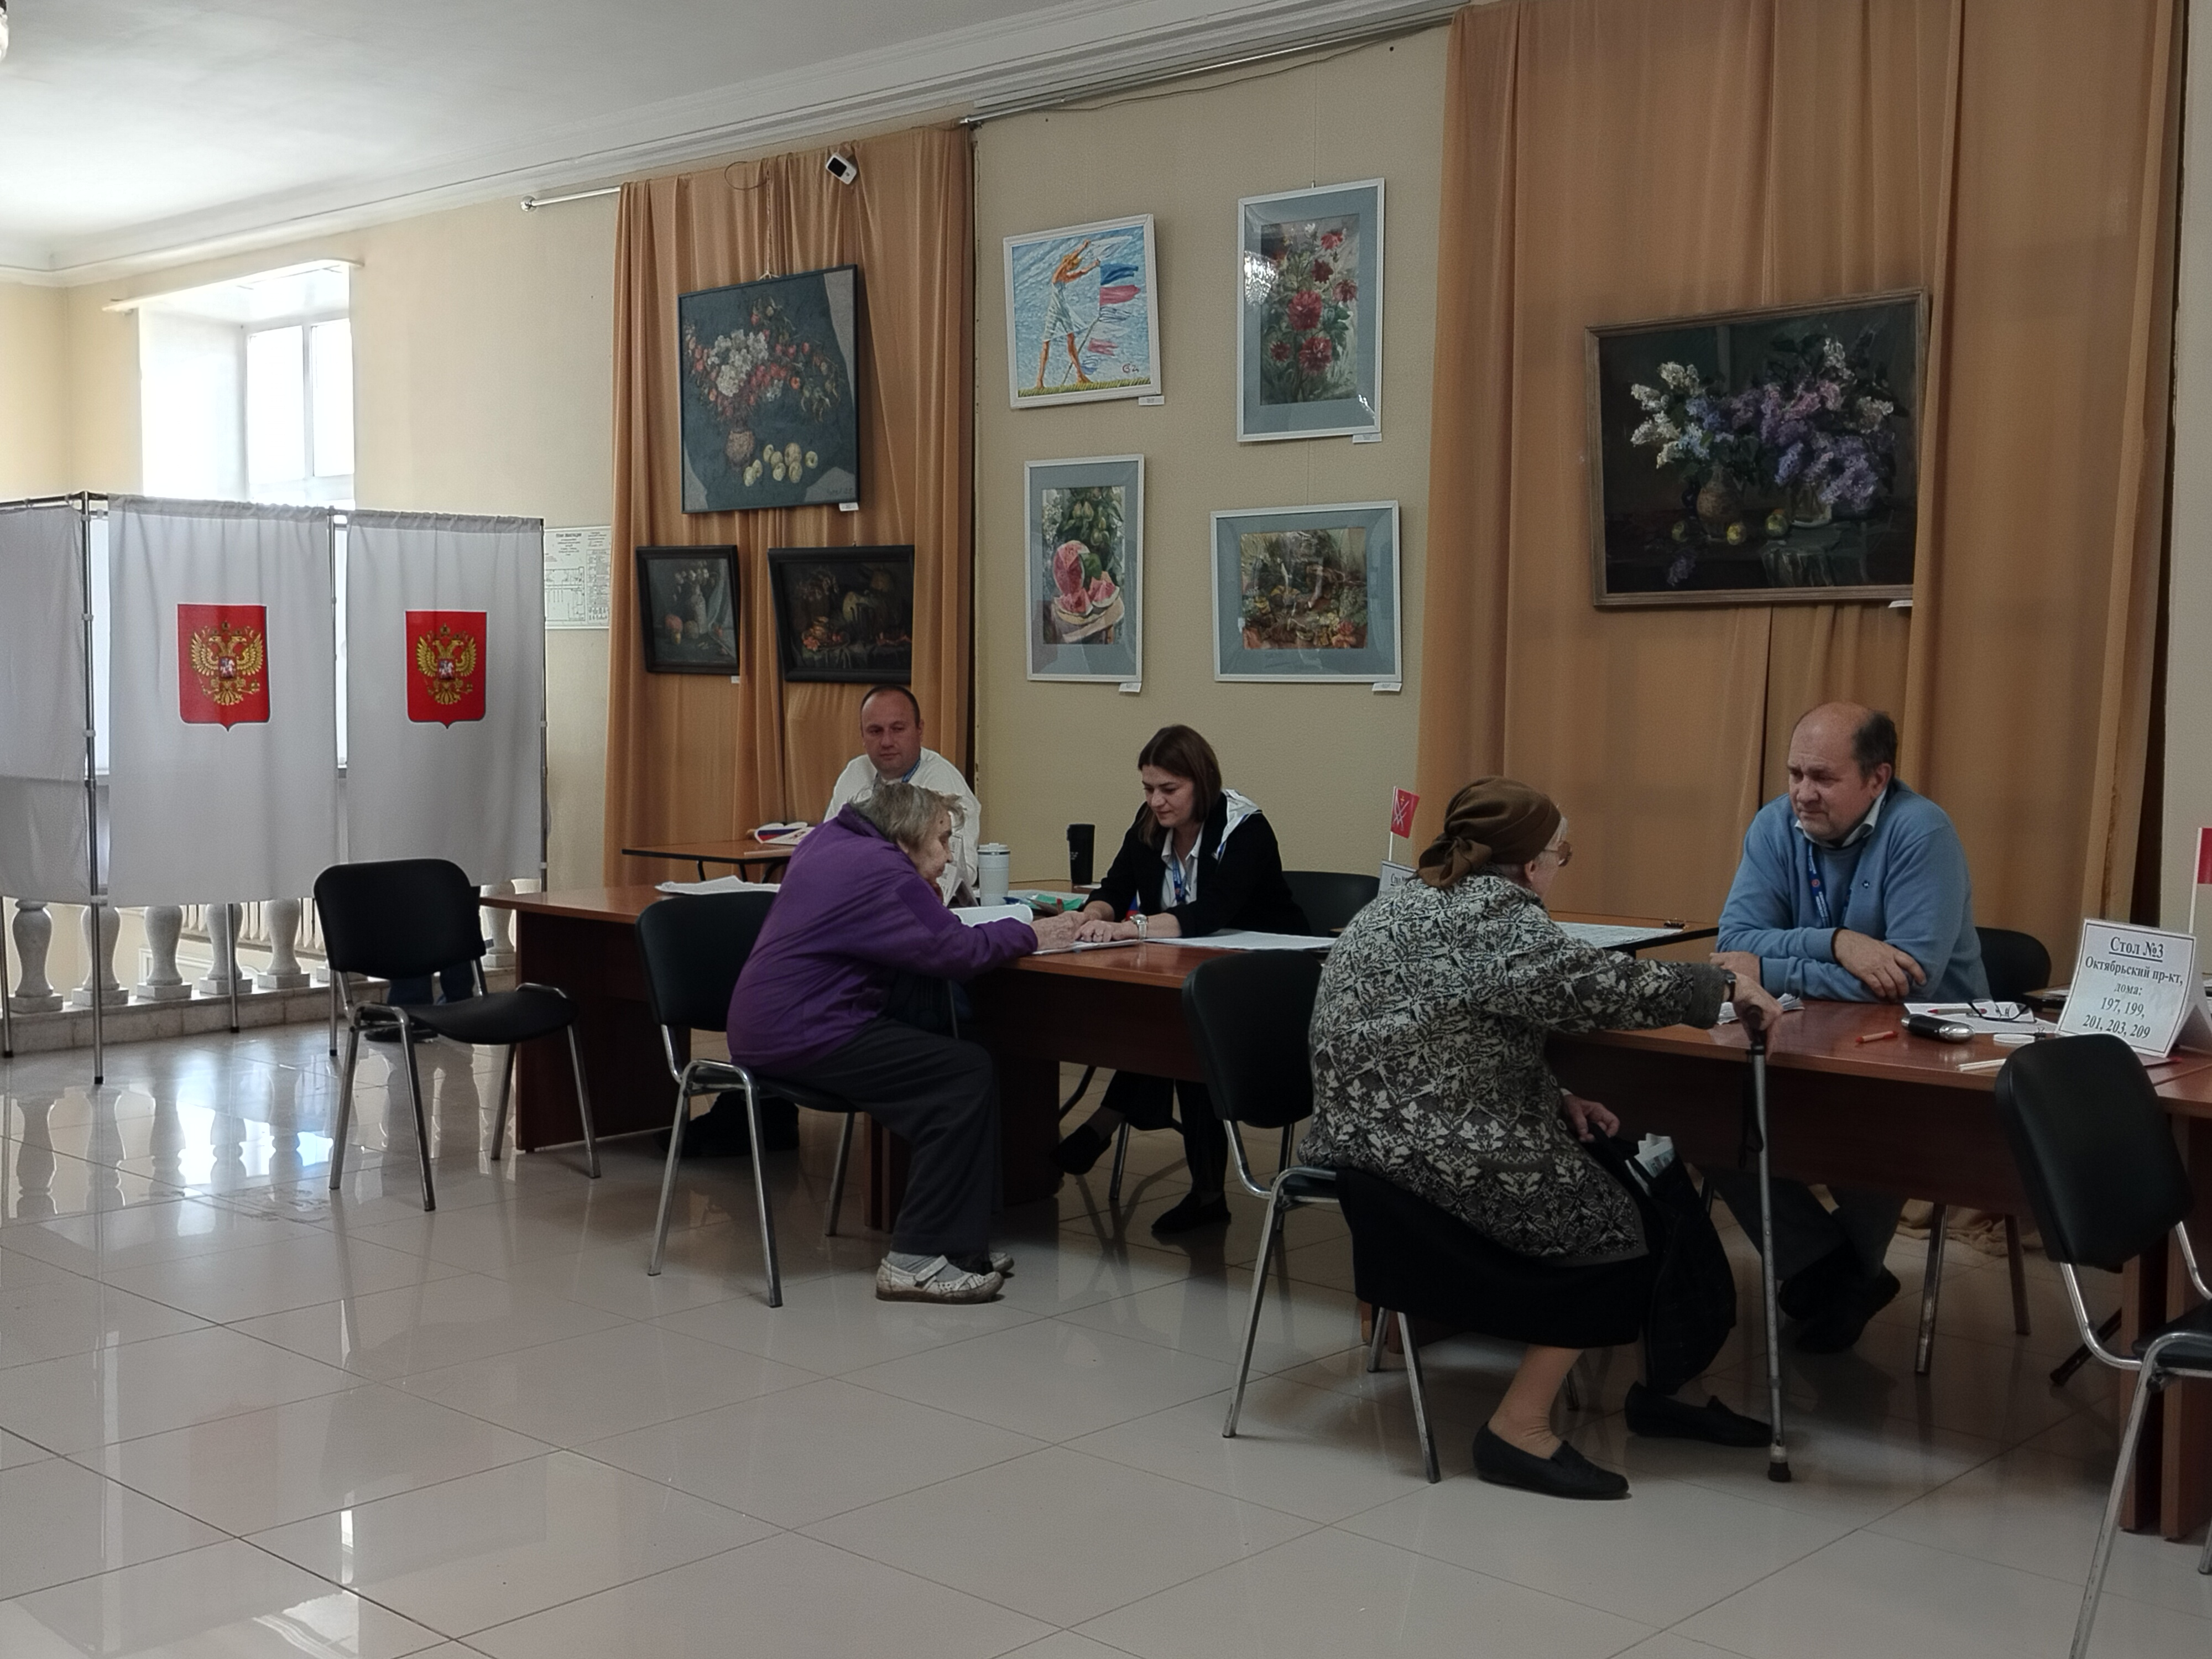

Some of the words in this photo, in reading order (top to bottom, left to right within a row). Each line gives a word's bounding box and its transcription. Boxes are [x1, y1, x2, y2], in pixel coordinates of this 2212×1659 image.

[2110, 937, 2140, 956] Стол
[2143, 941, 2164, 958] №3
[2085, 956, 2150, 978] Октябрьский
[2152, 970, 2183, 987] пр-кт,
[2114, 983, 2143, 996] дома:
[2101, 997, 2121, 1014] 197,
[2124, 1001, 2145, 1019] 199,
[2083, 1014, 2103, 1031] 201,
[2106, 1019, 2127, 1037] 203,
[2130, 1024, 2151, 1039] 209
